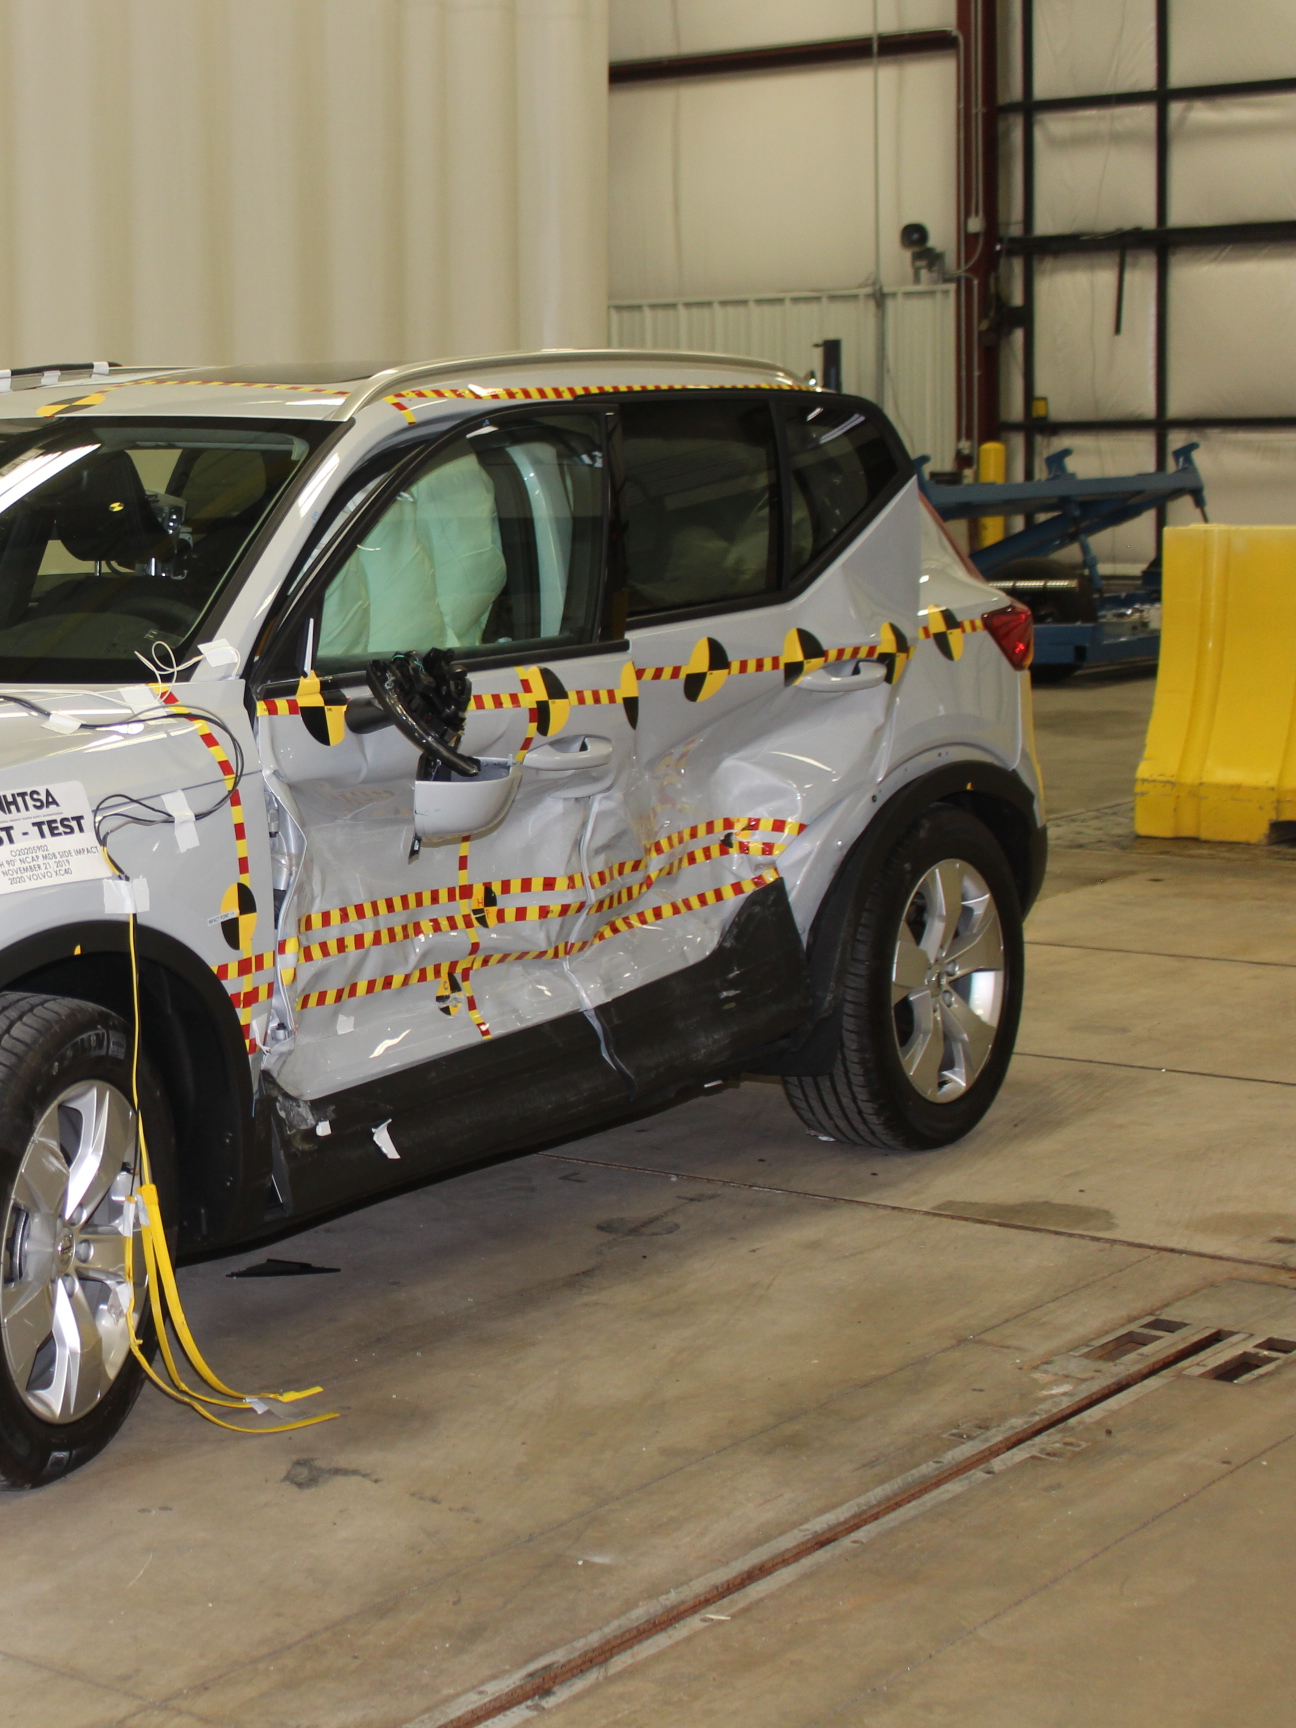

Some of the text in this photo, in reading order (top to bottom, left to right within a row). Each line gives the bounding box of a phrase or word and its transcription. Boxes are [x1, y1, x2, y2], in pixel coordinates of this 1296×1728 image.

[32, 815, 85, 839] TEST
[19, 856, 40, 866] NCAP
[58, 849, 74, 860] SIDE
[74, 846, 99, 858] IMPACT
[1, 864, 42, 877] NOVEMBER
[54, 859, 71, 869] 2019
[8, 867, 72, 885] 2020 VOLVO XC40
